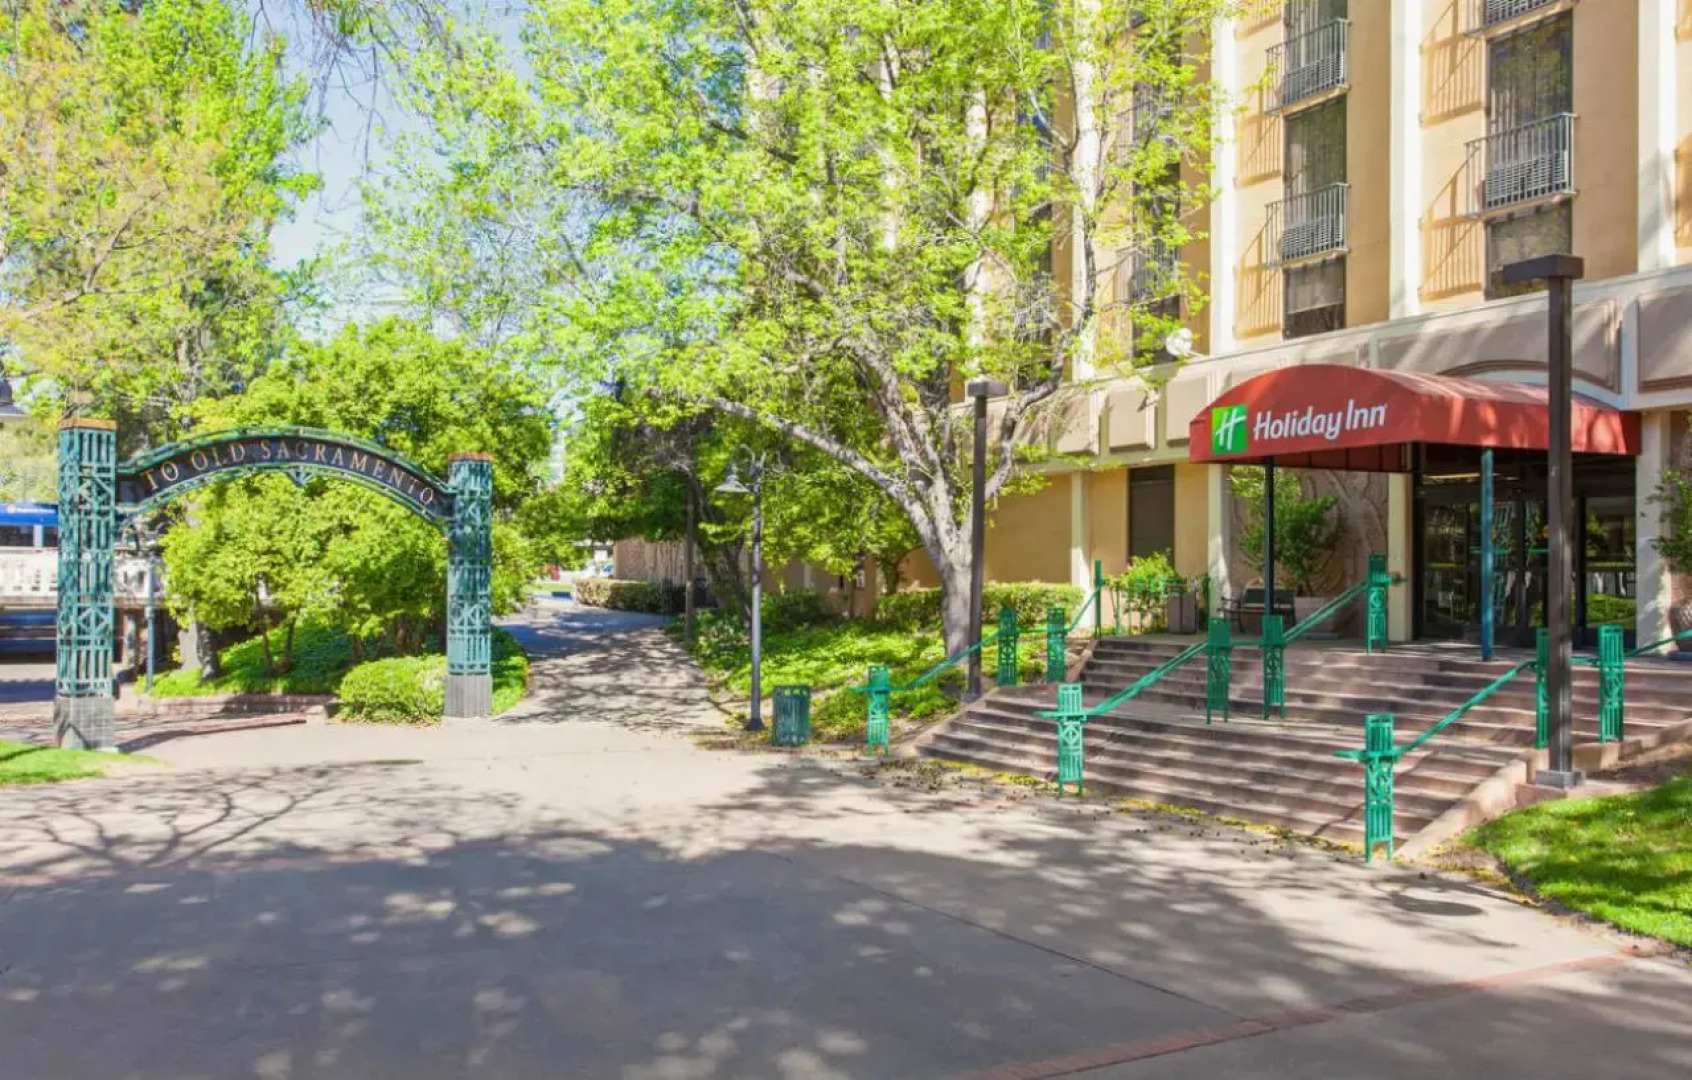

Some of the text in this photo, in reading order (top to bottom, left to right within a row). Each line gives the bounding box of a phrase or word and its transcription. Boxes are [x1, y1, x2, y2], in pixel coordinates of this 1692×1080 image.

[1253, 399, 1387, 440] Holiday Inn
[142, 439, 434, 505] TO OLD SACRAMENTO
